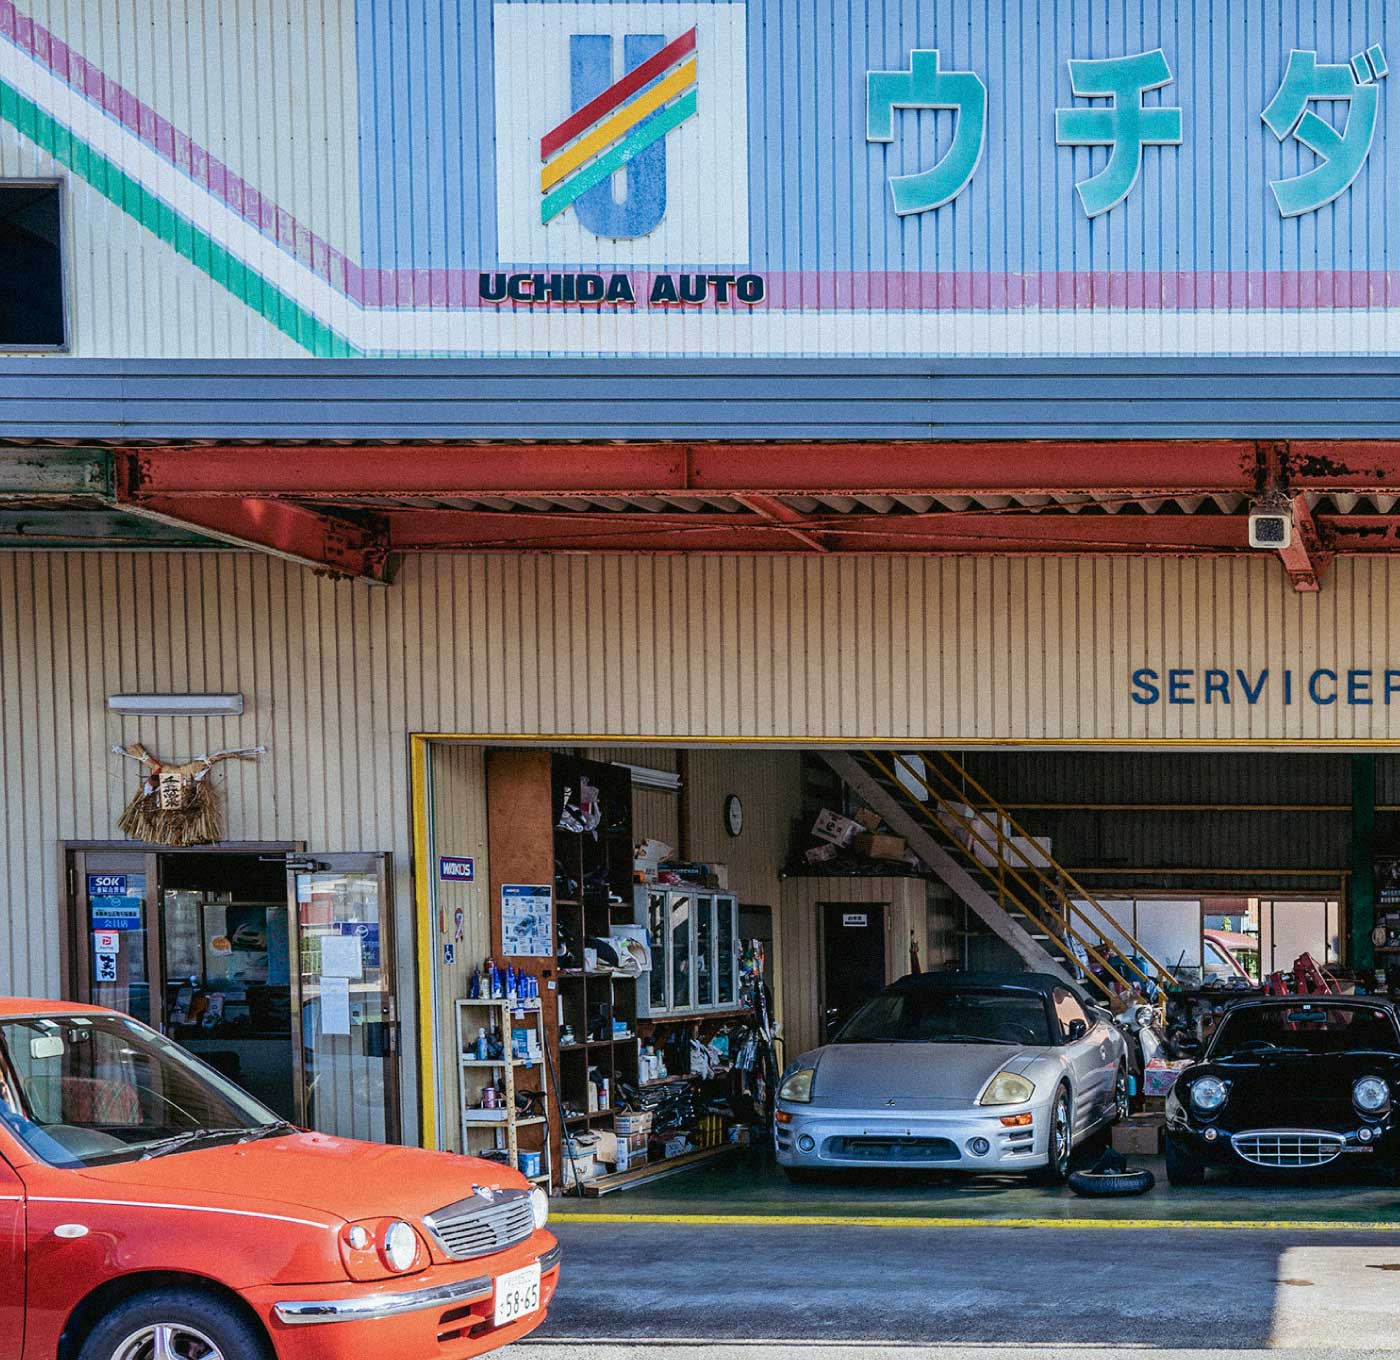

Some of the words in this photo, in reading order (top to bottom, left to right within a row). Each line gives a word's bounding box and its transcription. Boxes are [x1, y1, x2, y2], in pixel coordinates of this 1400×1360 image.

[478, 272, 635, 305] UCHIDA
[649, 273, 766, 306] AUTO
[95, 877, 120, 886] SOK
